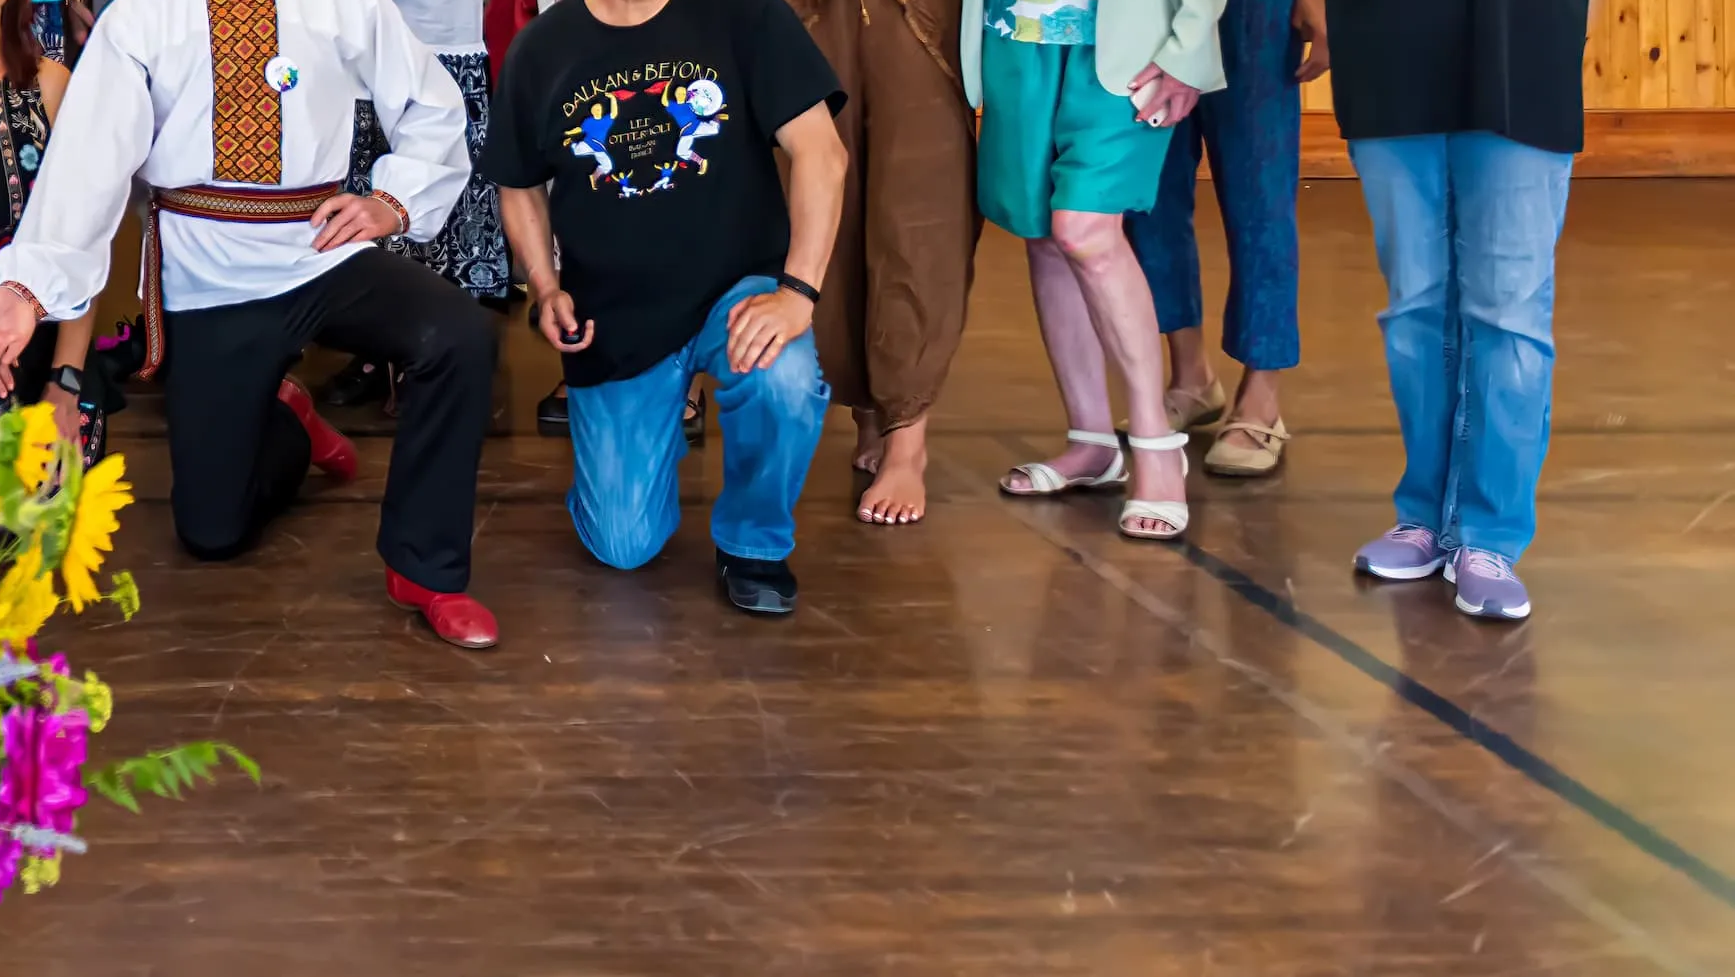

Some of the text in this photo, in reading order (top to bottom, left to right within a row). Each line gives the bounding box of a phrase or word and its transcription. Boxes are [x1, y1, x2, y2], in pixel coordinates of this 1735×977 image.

[562, 61, 718, 118] BALKAN & BEYOND
